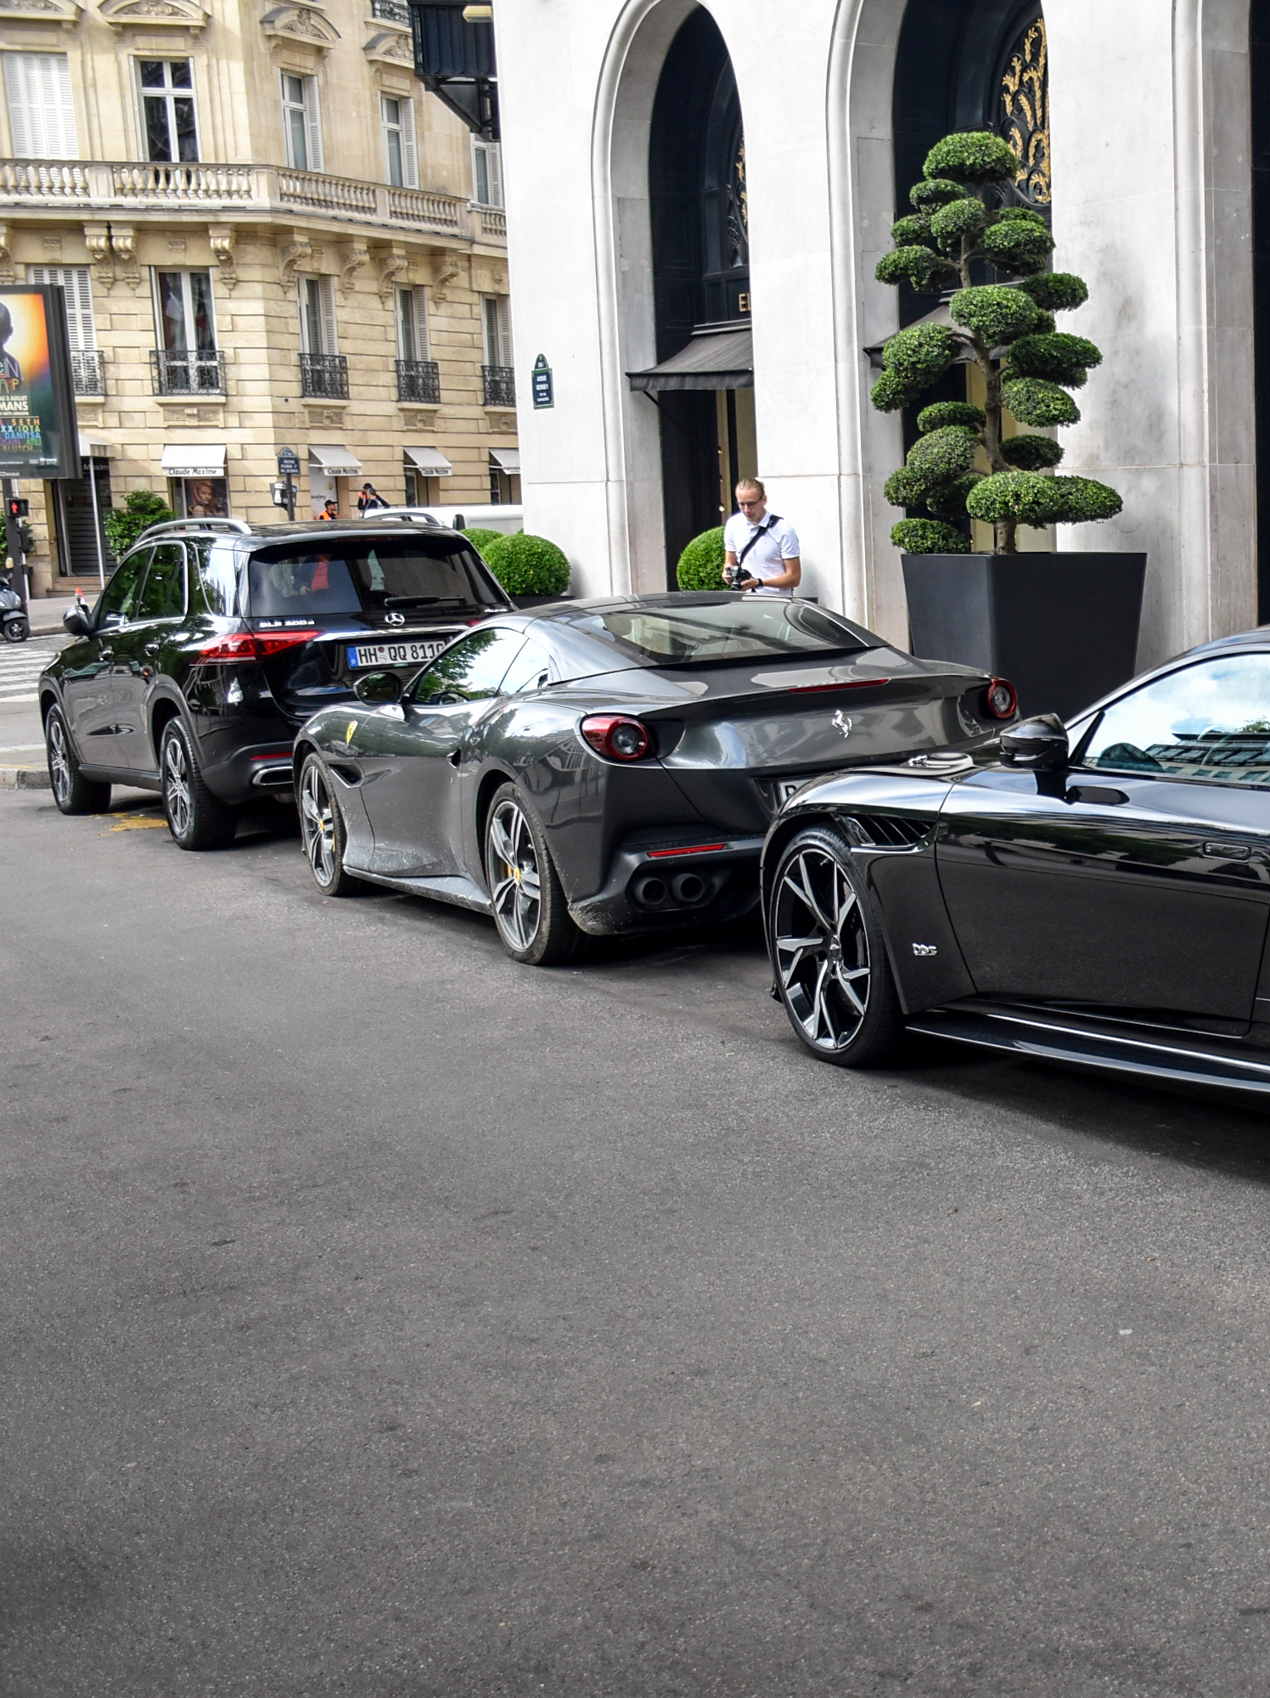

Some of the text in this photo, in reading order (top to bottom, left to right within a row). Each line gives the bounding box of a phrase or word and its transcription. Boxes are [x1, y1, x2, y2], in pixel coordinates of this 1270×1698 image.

[0, 401, 29, 411] MANS
[168, 467, 217, 475] Claude Maxime
[358, 647, 378, 664] HH
[388, 645, 408, 661] QQ
